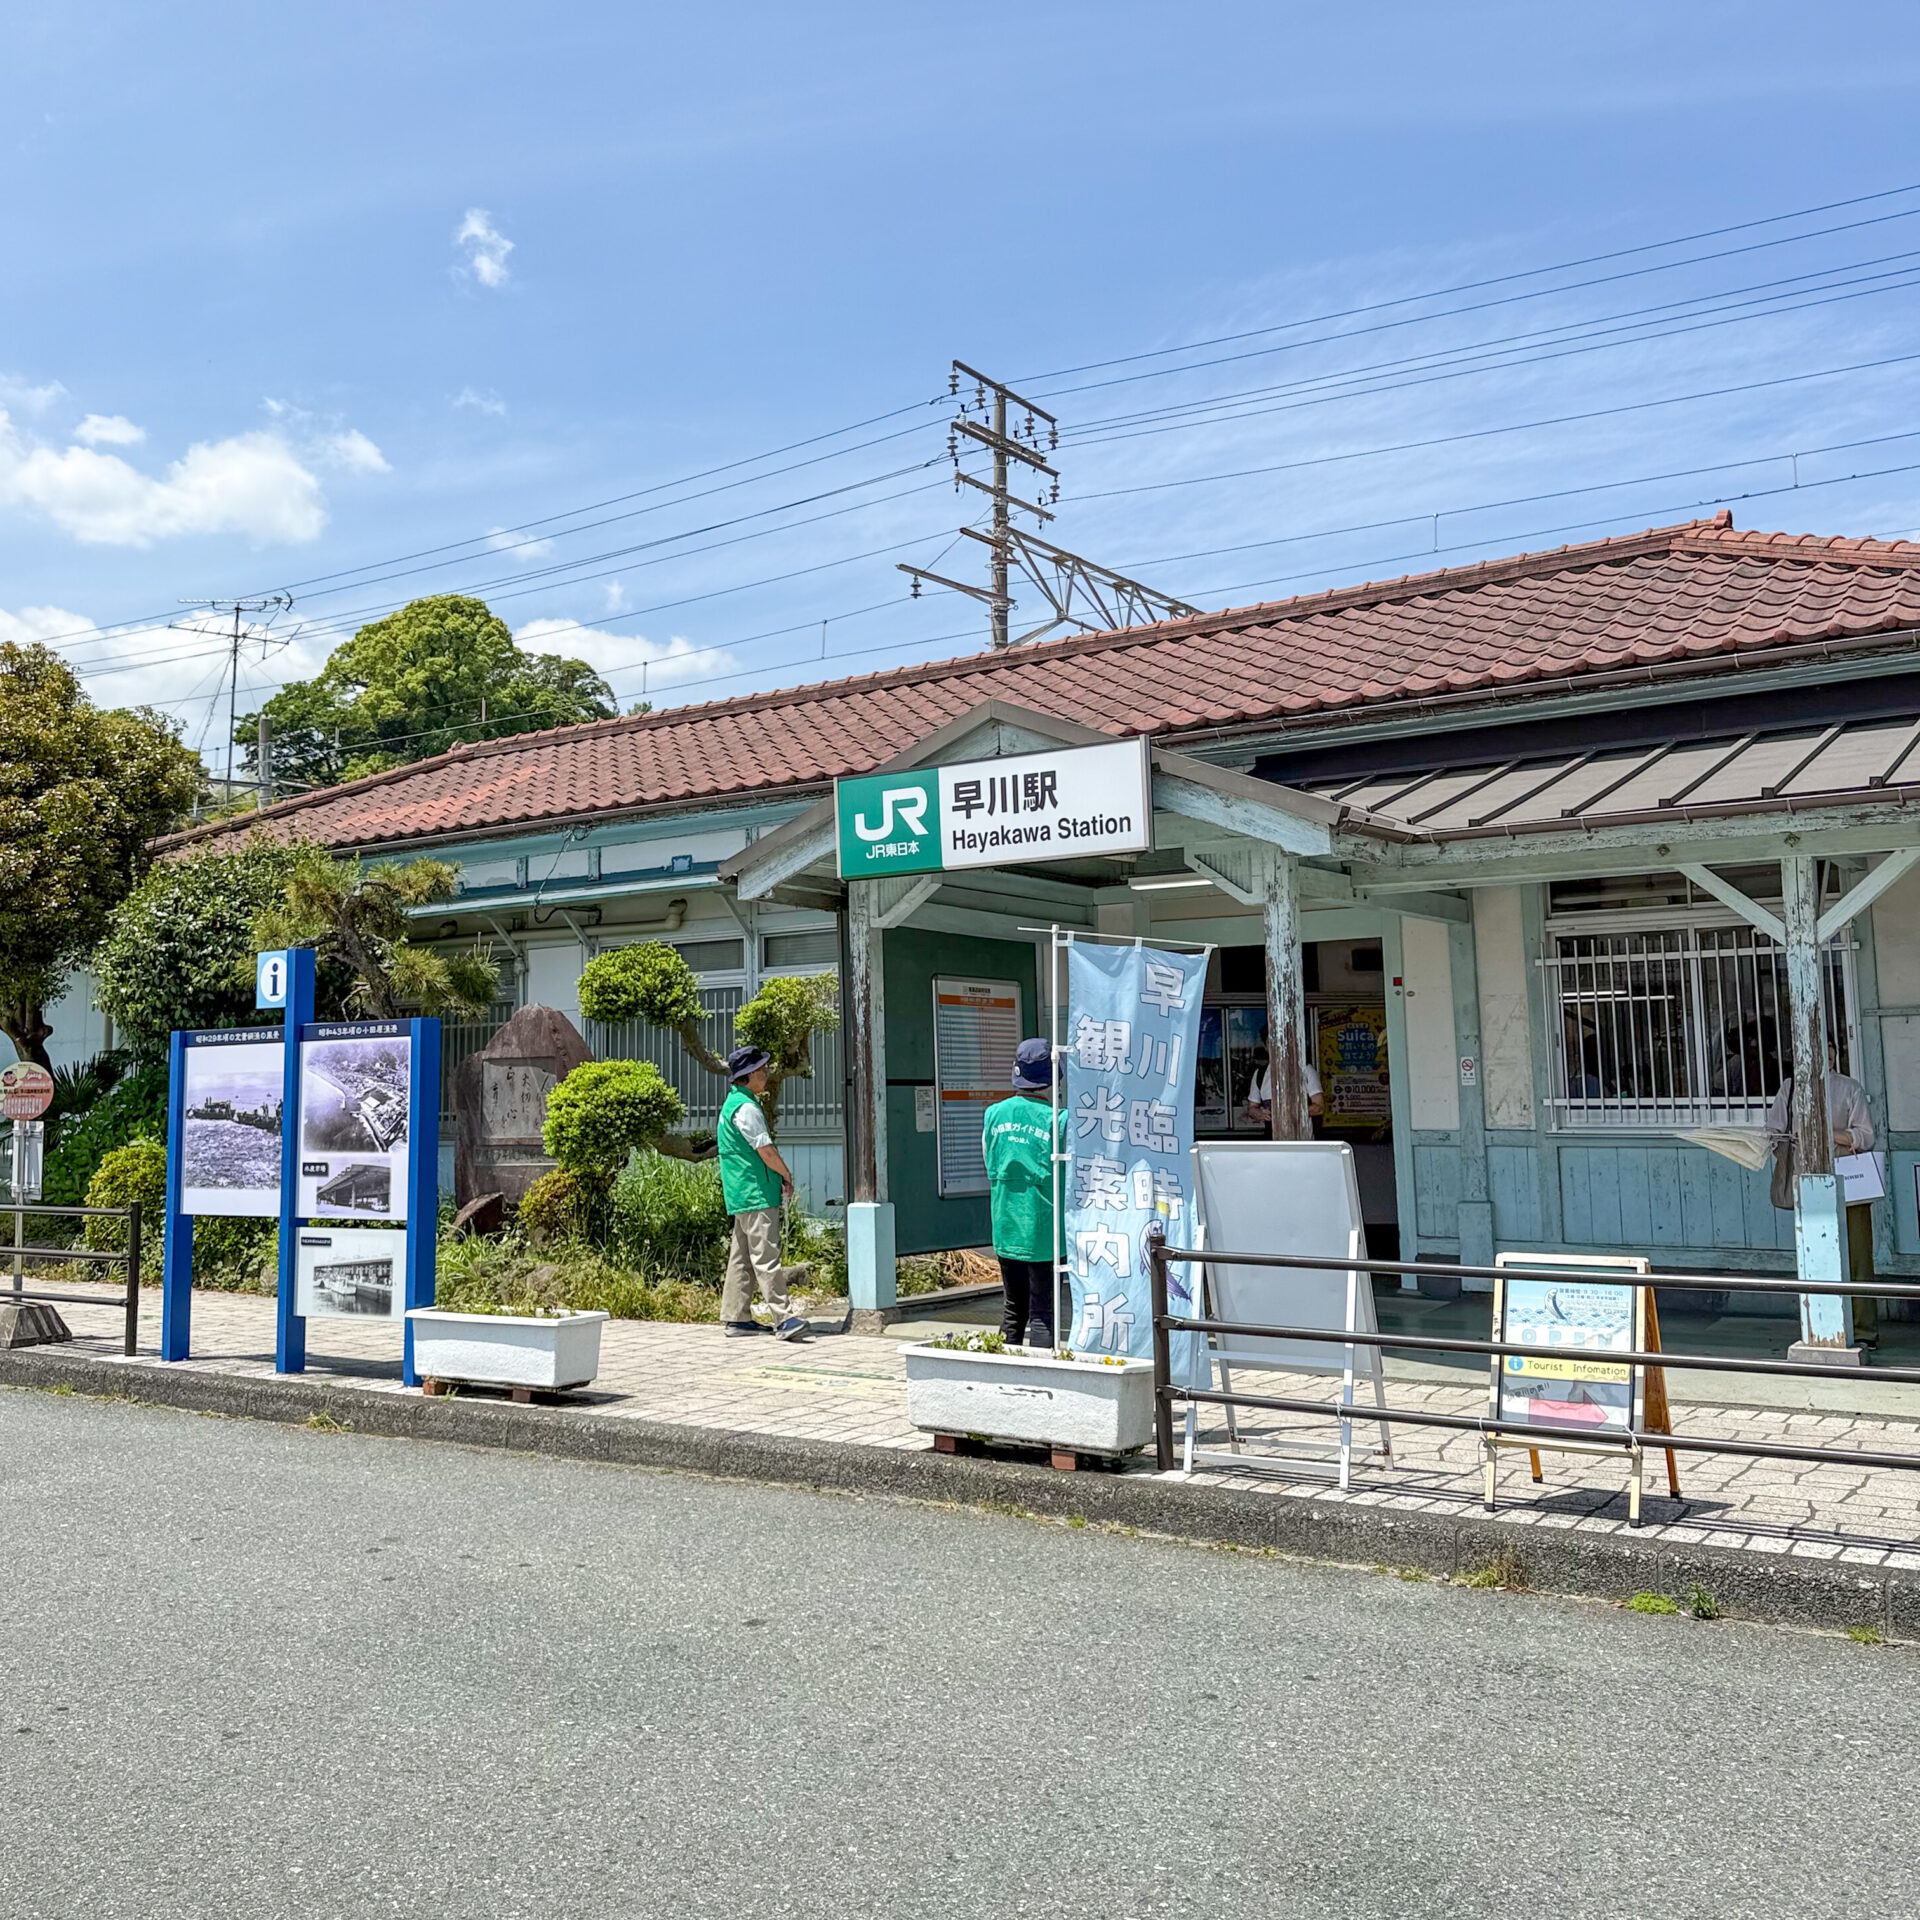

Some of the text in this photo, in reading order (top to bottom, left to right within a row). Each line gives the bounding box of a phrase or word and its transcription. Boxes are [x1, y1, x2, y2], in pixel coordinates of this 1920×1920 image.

[854, 786, 929, 842] JR
[952, 770, 1058, 819] 早川駅
[866, 840, 920, 859] JR東日本
[952, 813, 1131, 853] Hayakawa Station
[1337, 1030, 1374, 1042] Suica
[1128, 961, 1187, 1221] 早川臨時
[1074, 1013, 1135, 1353] 観光案内所
[1527, 1360, 1563, 1371] Tourist
[1573, 1363, 1626, 1376] Infomation
